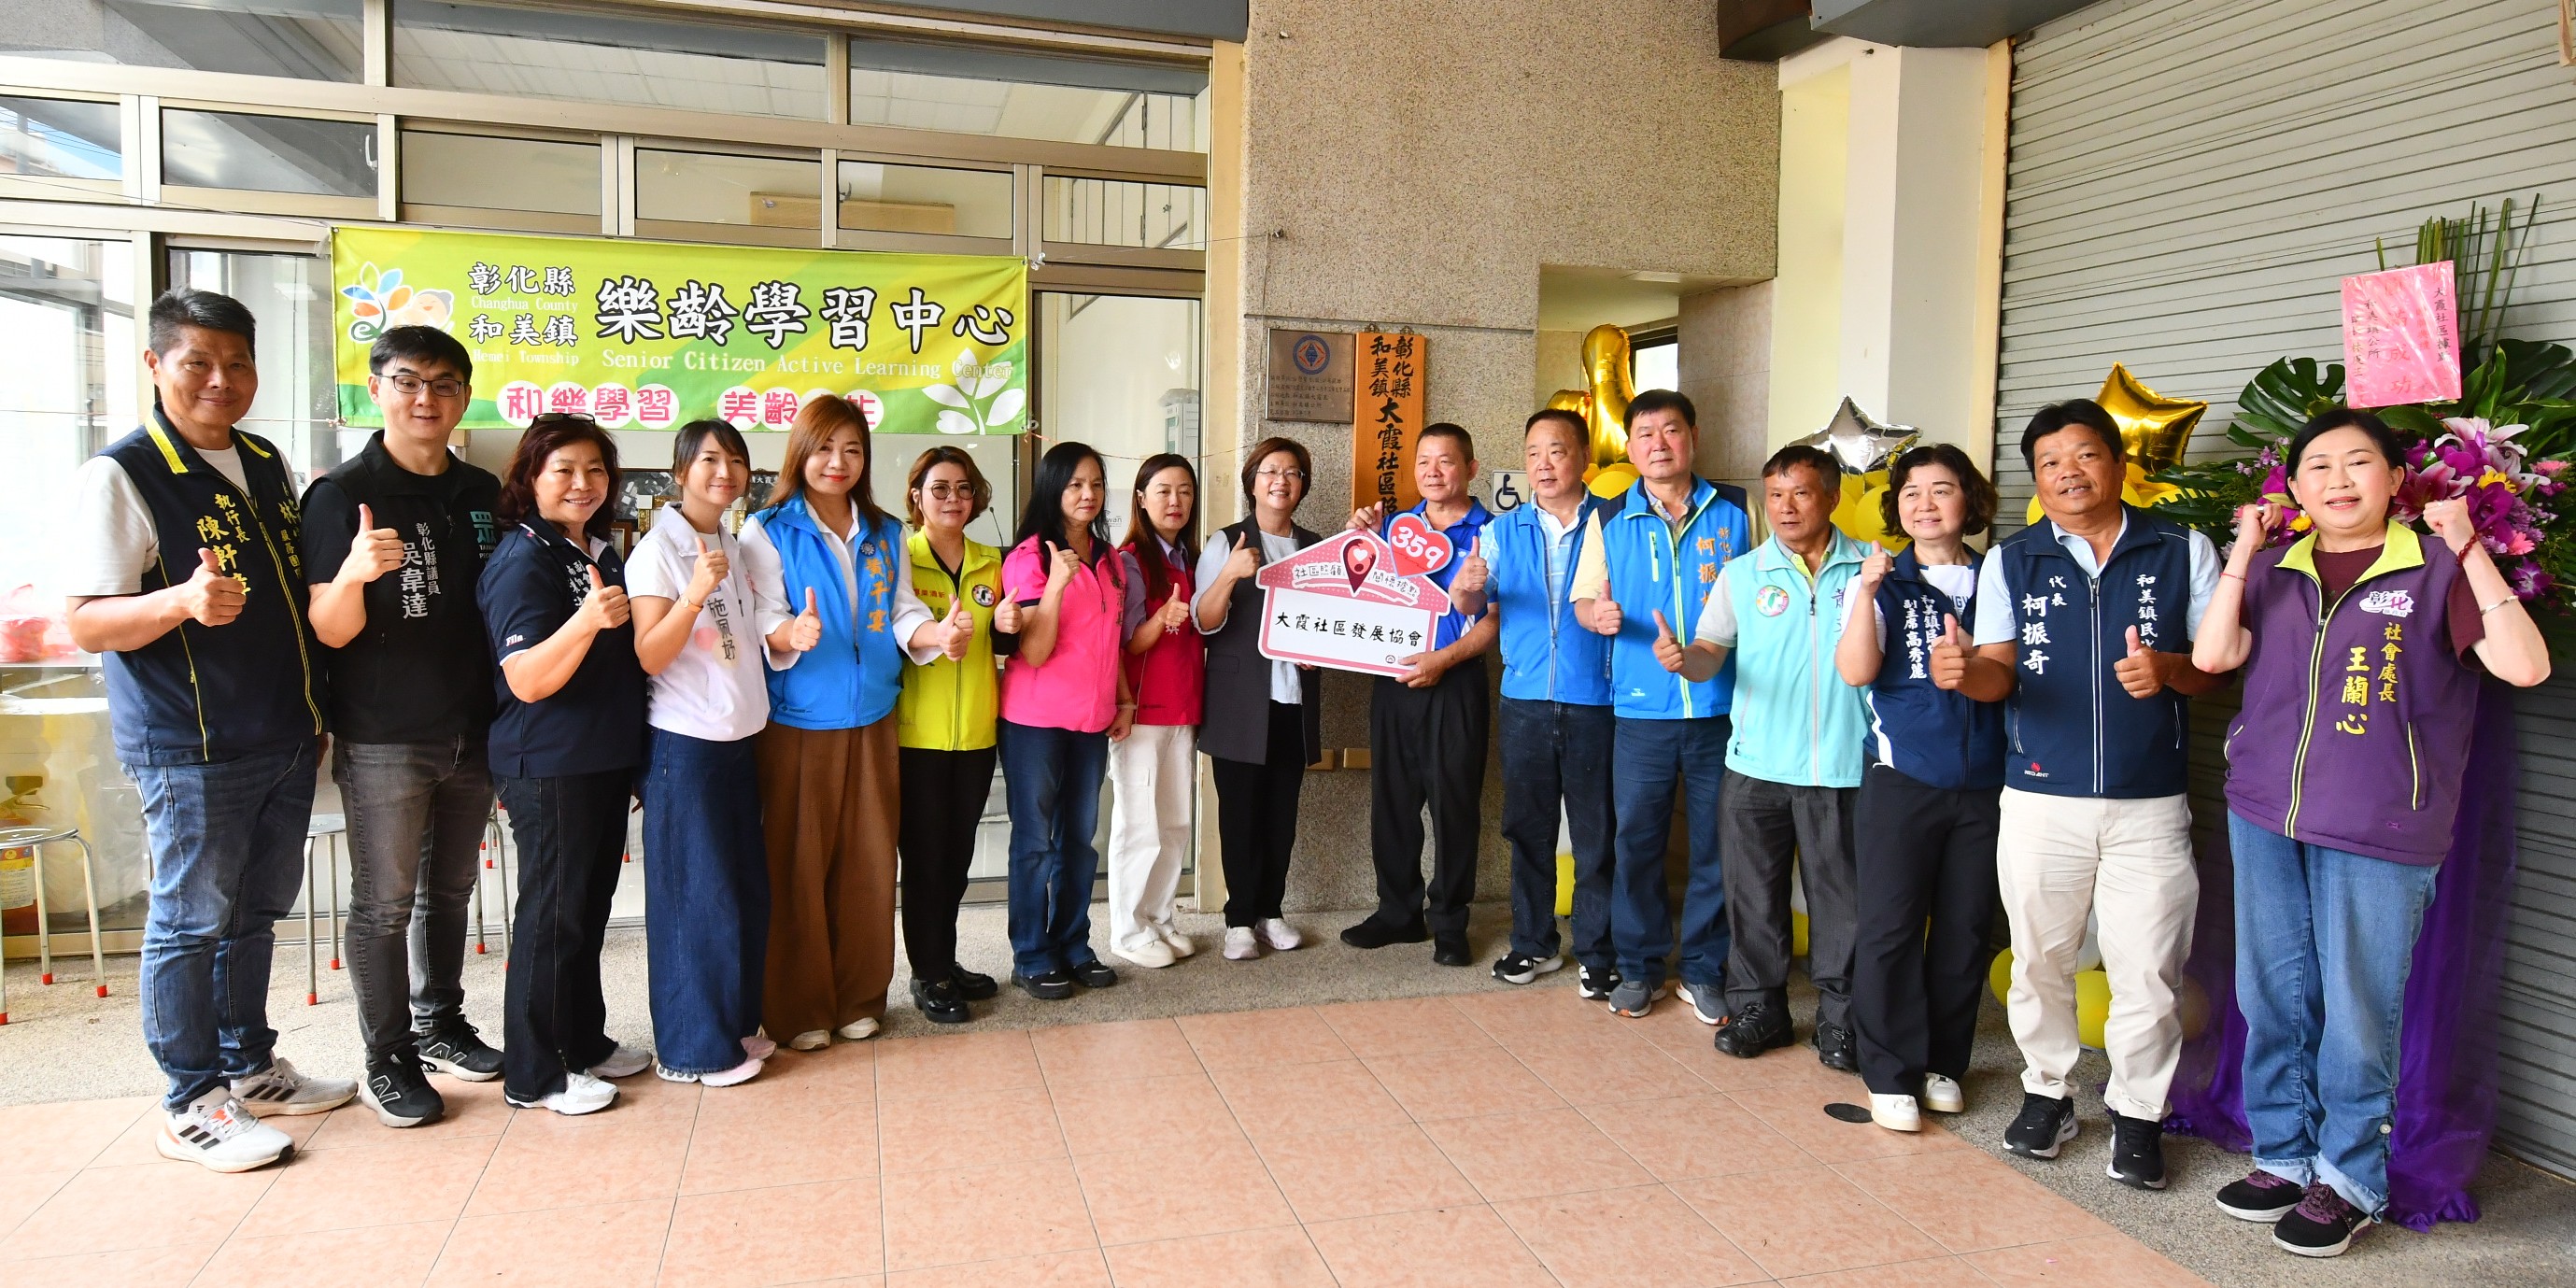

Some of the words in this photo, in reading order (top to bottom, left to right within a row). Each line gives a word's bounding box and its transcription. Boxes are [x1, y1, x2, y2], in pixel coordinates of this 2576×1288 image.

[468, 262, 575, 297] 彰化縣
[471, 296, 529, 311] Changhua
[536, 299, 578, 314] County
[594, 276, 1015, 354] 樂齡學習中心
[469, 313, 578, 347] 和美鎮
[474, 349, 509, 362] Hemei
[519, 350, 579, 365] Township
[602, 349, 671, 370] Senior
[684, 351, 766, 372] Citizen
[777, 359, 843, 375] Active
[855, 359, 941, 379] Learning
[951, 360, 1013, 379] Center
[1369, 335, 1390, 398] 和美鎮
[1391, 335, 1413, 398] 彰化縣
[506, 387, 671, 421] 和樂學習
[214, 493, 250, 544] 執行長
[416, 522, 441, 596] 彰化縣議員
[1392, 526, 1444, 569] 359
[399, 542, 429, 619] 吳韋達
[2049, 575, 2068, 607] 代表
[1275, 612, 1422, 647] 大霞社區發展協會
[2022, 592, 2051, 675] 柯振奇
[2378, 622, 2402, 702] 社會處長
[2336, 646, 2370, 735] 王蘭心
